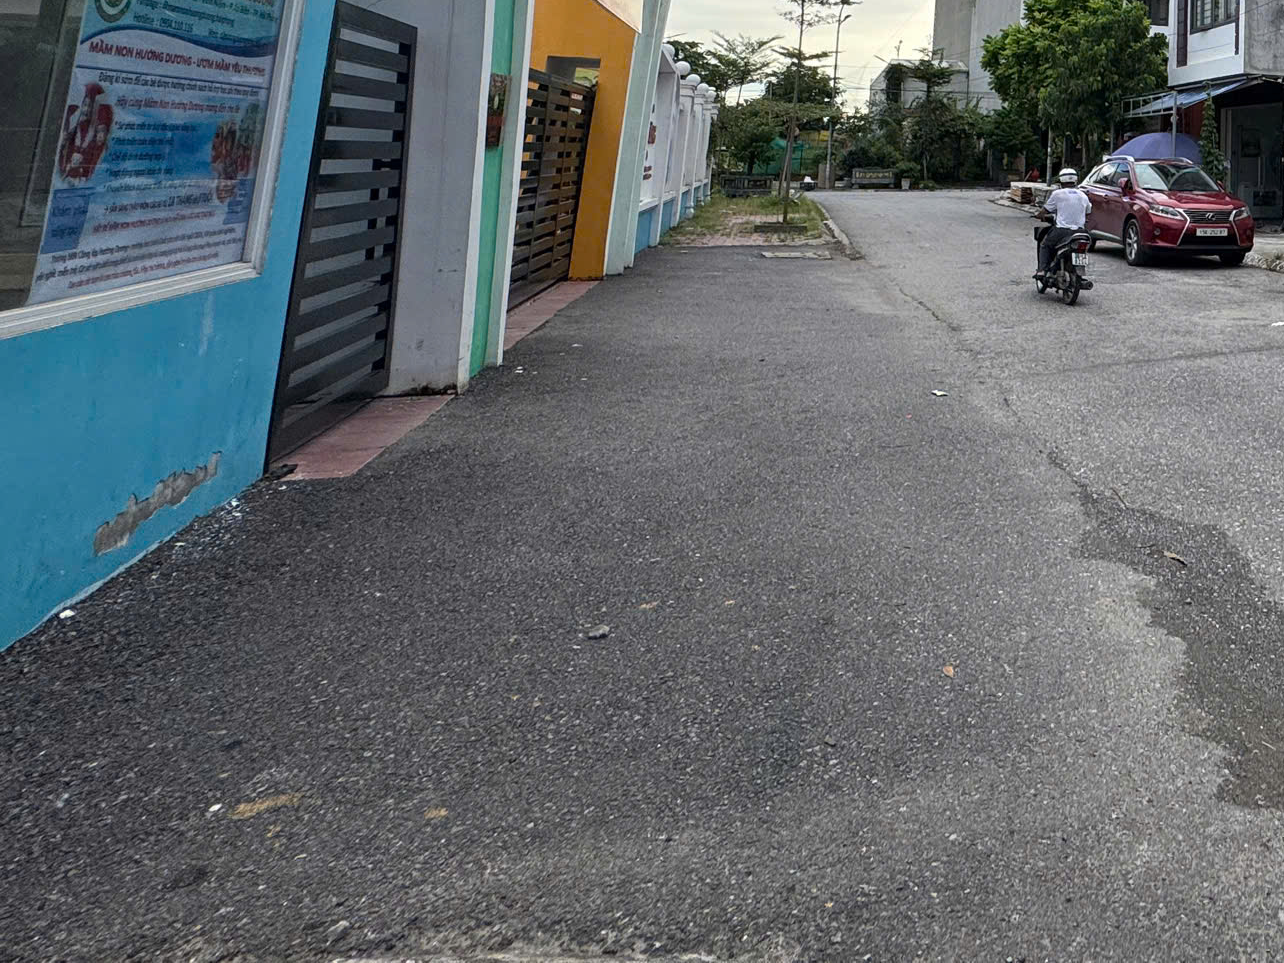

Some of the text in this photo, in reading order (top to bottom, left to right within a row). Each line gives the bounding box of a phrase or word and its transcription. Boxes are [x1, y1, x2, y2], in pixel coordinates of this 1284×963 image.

[89, 39, 113, 55] MẦM
[115, 43, 134, 59] NON
[165, 51, 192, 67] DƯƠNG
